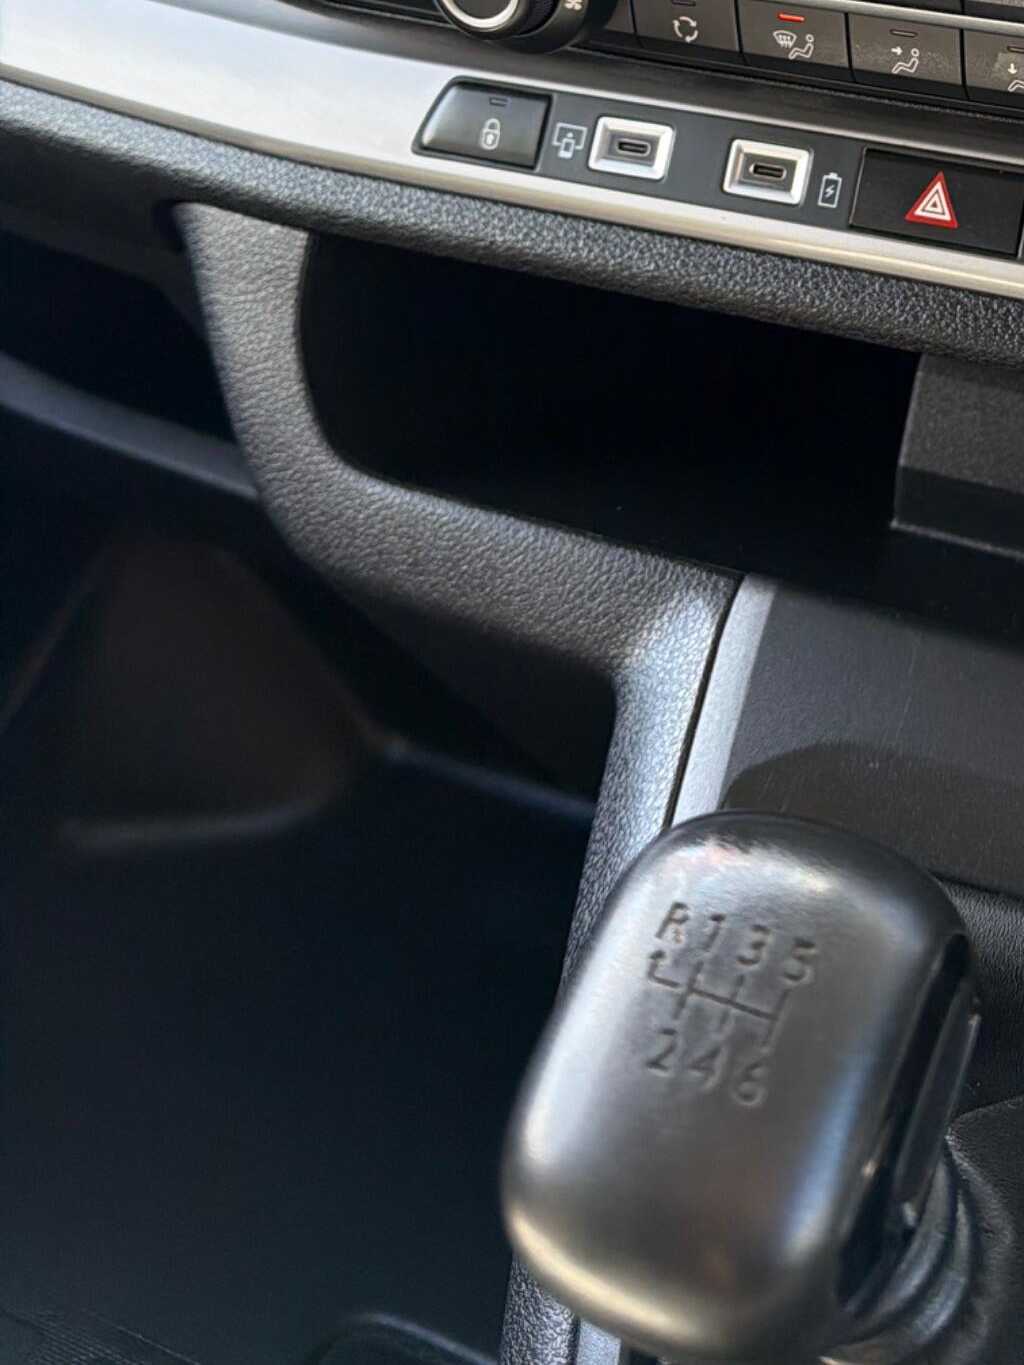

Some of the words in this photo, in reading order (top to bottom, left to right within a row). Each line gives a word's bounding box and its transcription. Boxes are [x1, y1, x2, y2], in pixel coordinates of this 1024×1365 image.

[656, 901, 690, 940] R
[736, 924, 770, 967] 3
[781, 937, 818, 985] 5
[646, 1028, 678, 1075] 2
[688, 1043, 728, 1091] 4
[728, 1062, 767, 1106] 6
